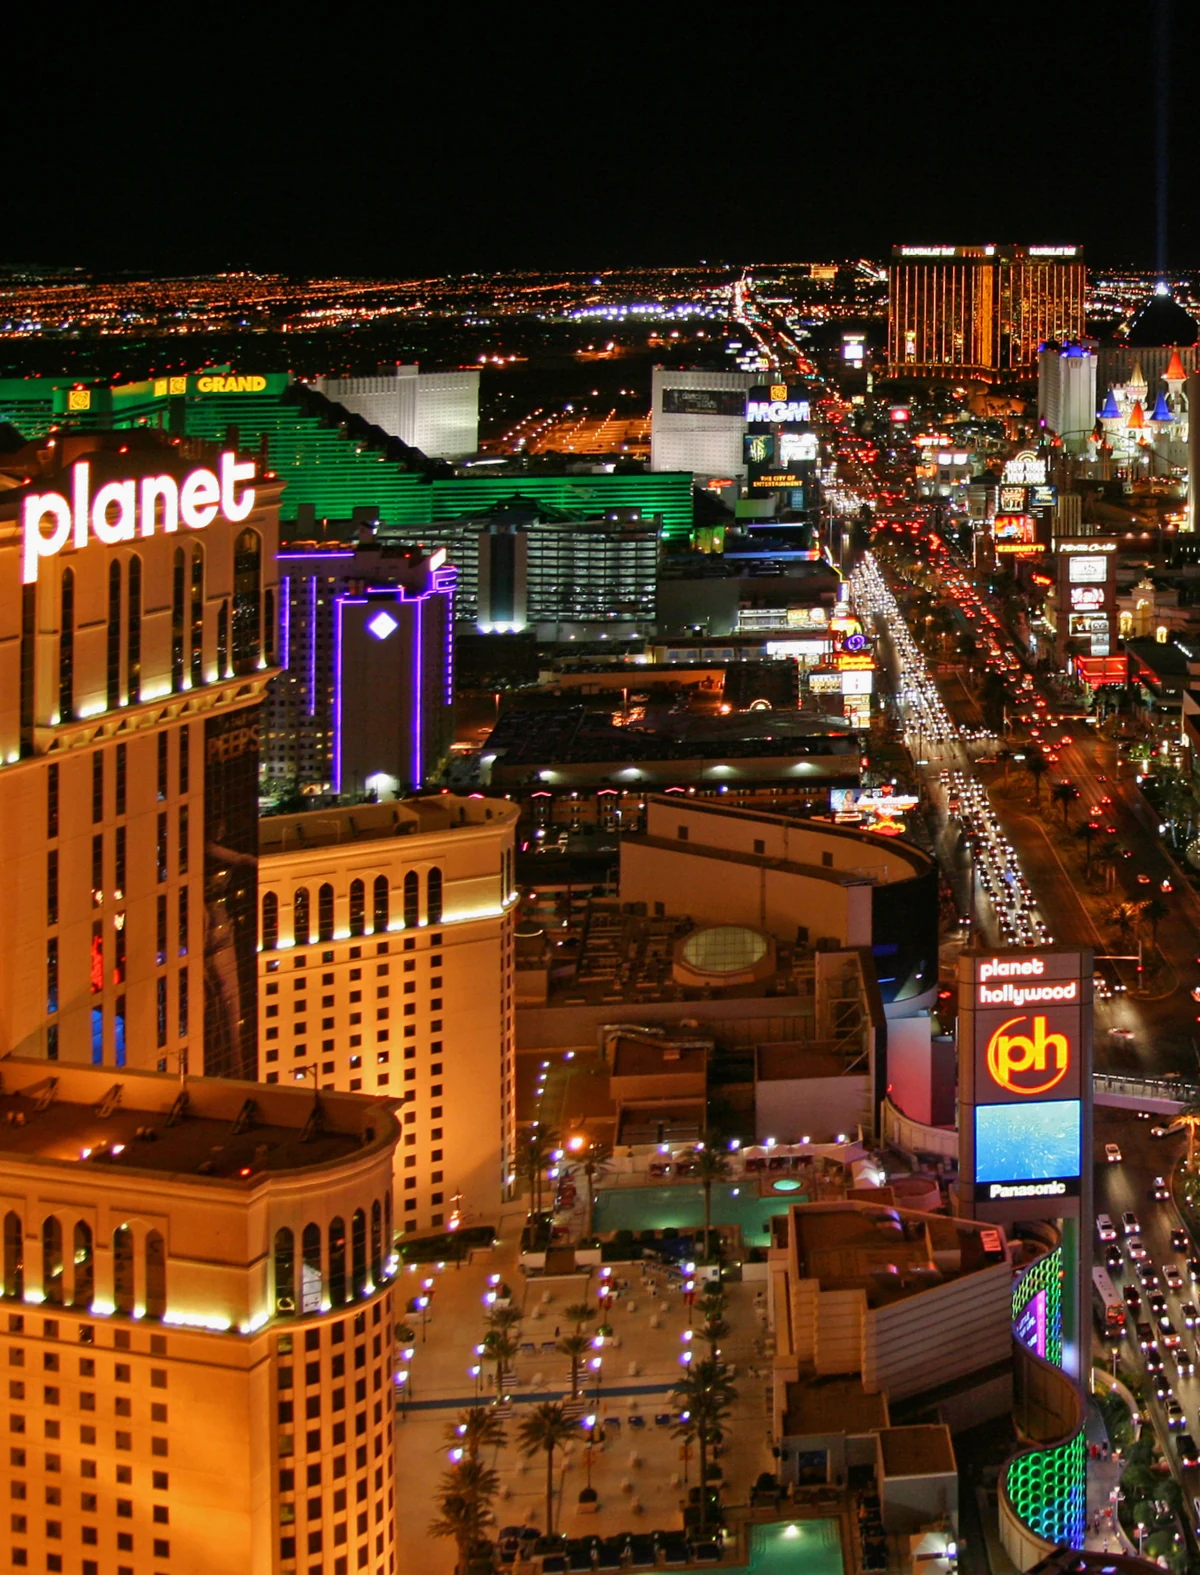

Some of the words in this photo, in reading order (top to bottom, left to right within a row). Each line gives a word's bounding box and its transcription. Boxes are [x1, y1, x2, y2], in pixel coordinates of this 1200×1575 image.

[198, 376, 267, 392] GRAND
[746, 401, 810, 422] MGM
[22, 452, 256, 584] planet
[980, 958, 1044, 982] planet
[980, 982, 1077, 1005] hollywood
[990, 1181, 1066, 1198] Panasonic
